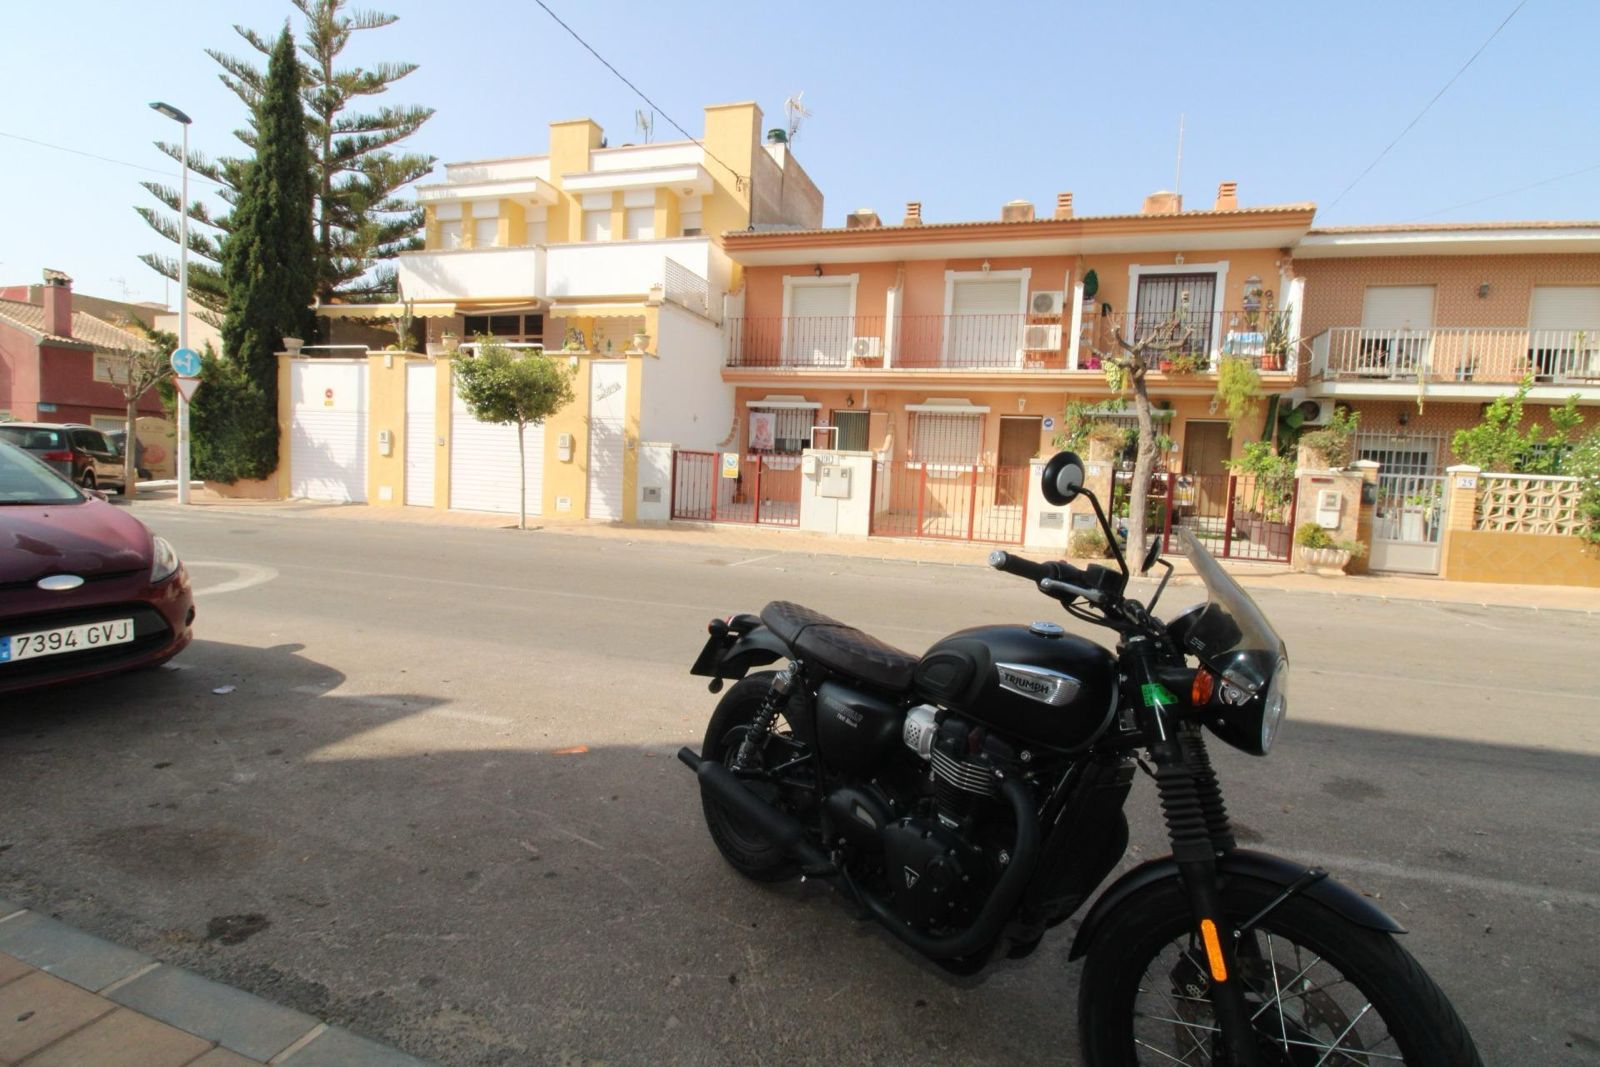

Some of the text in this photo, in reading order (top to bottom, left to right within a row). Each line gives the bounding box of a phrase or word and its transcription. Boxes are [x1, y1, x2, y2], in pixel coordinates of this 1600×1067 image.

[17, 622, 127, 656] 7394 GVJ
[1004, 672, 1049, 694] TRIUMPH
